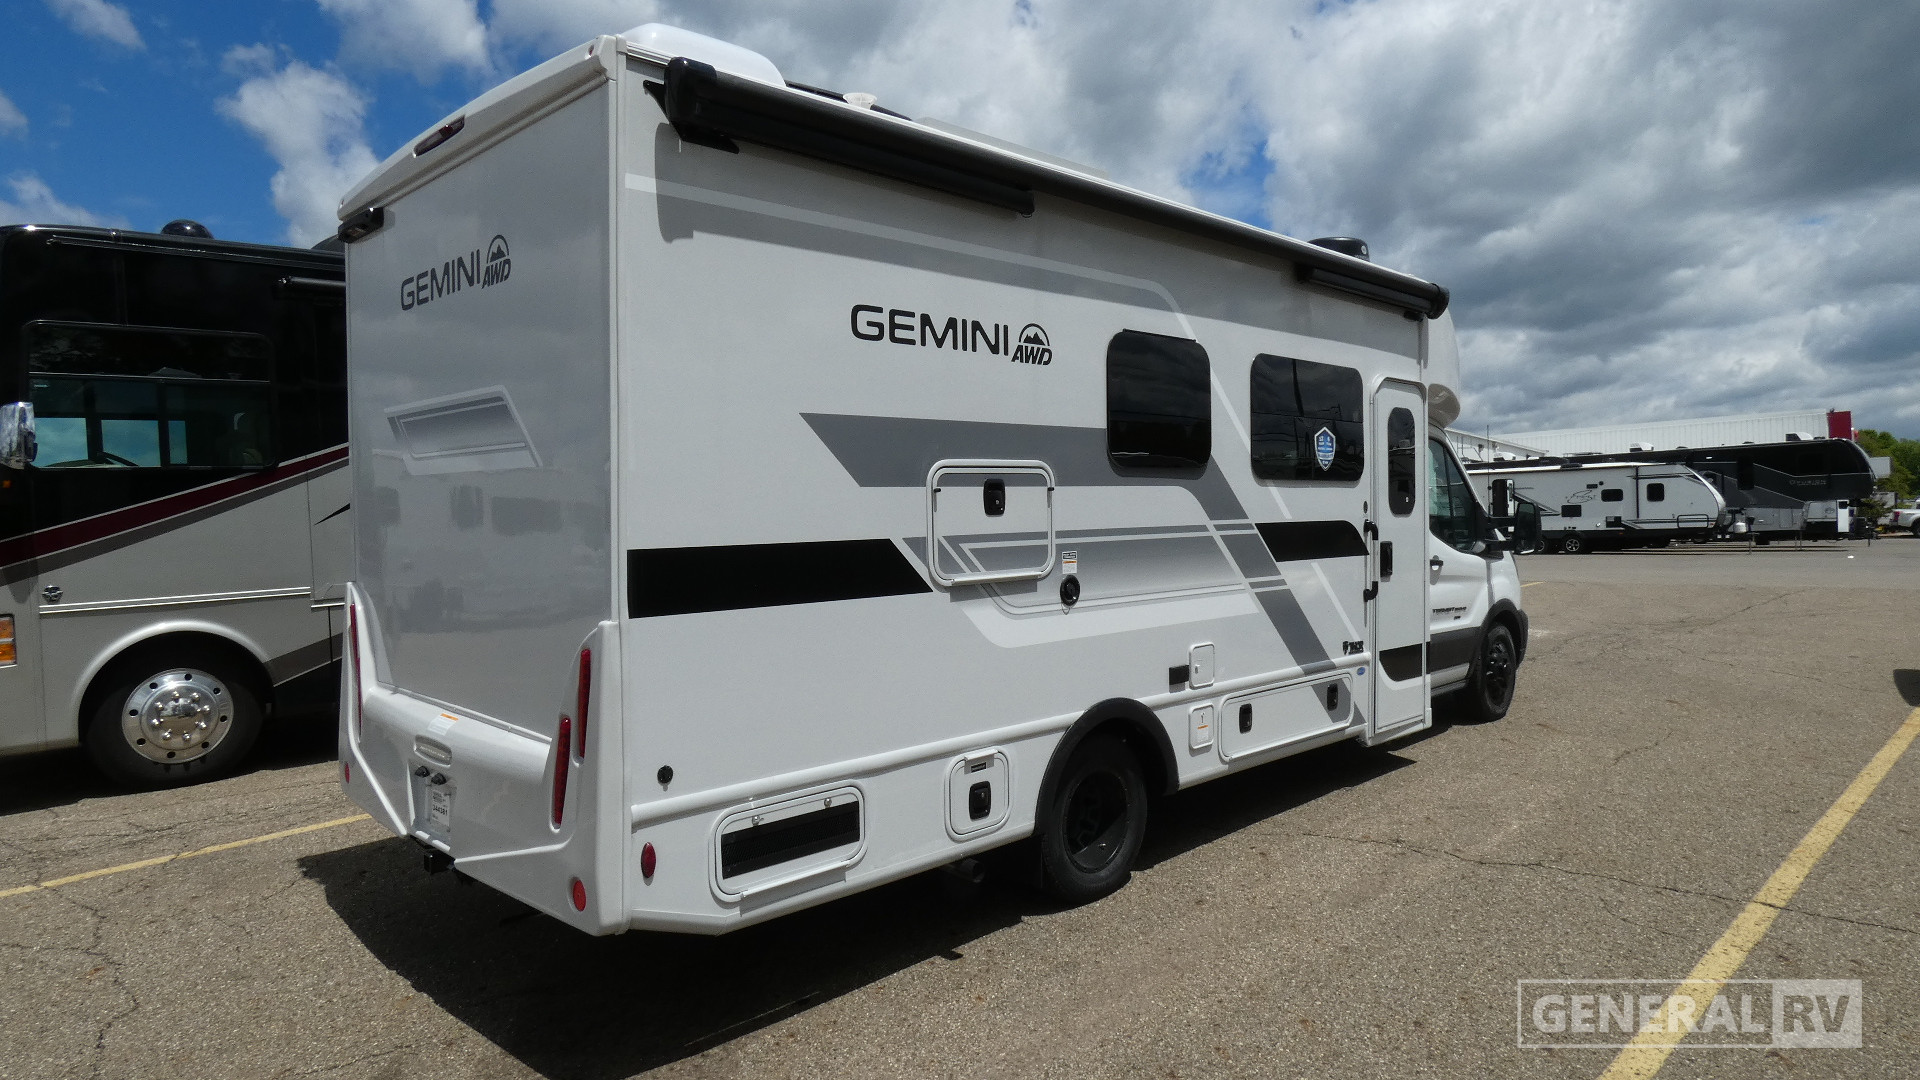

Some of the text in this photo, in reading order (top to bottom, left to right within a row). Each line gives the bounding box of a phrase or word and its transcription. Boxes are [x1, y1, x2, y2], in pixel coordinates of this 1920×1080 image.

[401, 249, 511, 311] GEMINI AWD
[851, 304, 1053, 366] GEMINI AWD
